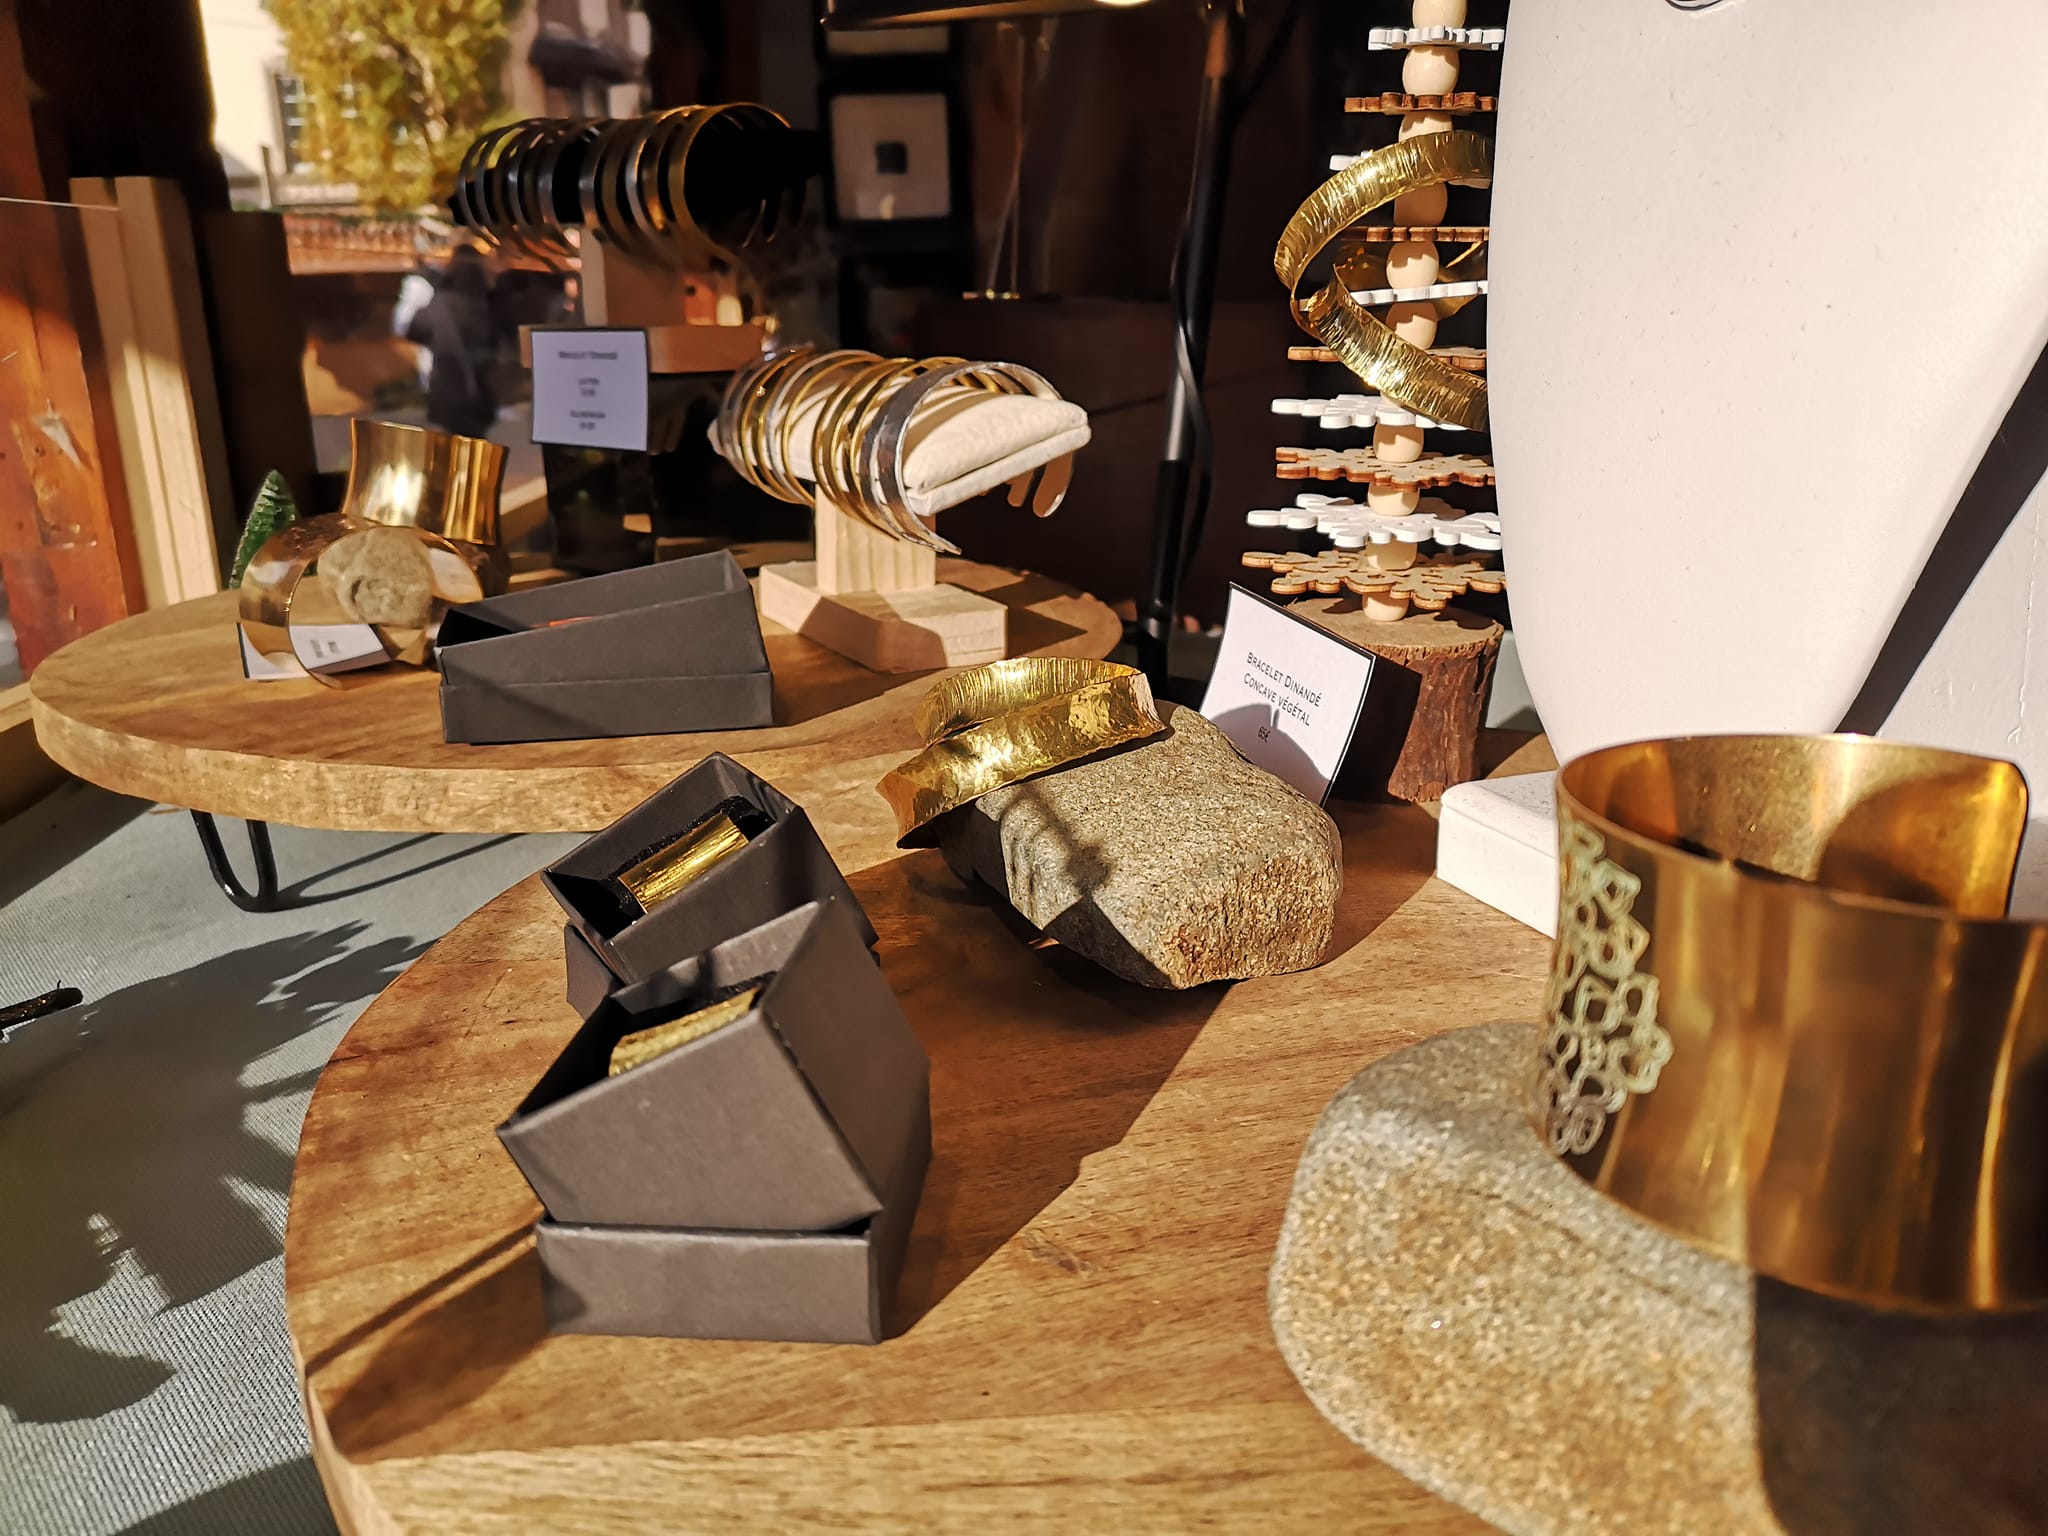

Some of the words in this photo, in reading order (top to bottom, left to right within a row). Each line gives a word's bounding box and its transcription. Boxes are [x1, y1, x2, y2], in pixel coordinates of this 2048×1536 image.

[1244, 673, 1277, 703] CONCAVE
[1278, 695, 1311, 726] VÉGÉTAL
[1247, 652, 1284, 682] BRACELET
[1284, 675, 1322, 707] DINANDÉ
